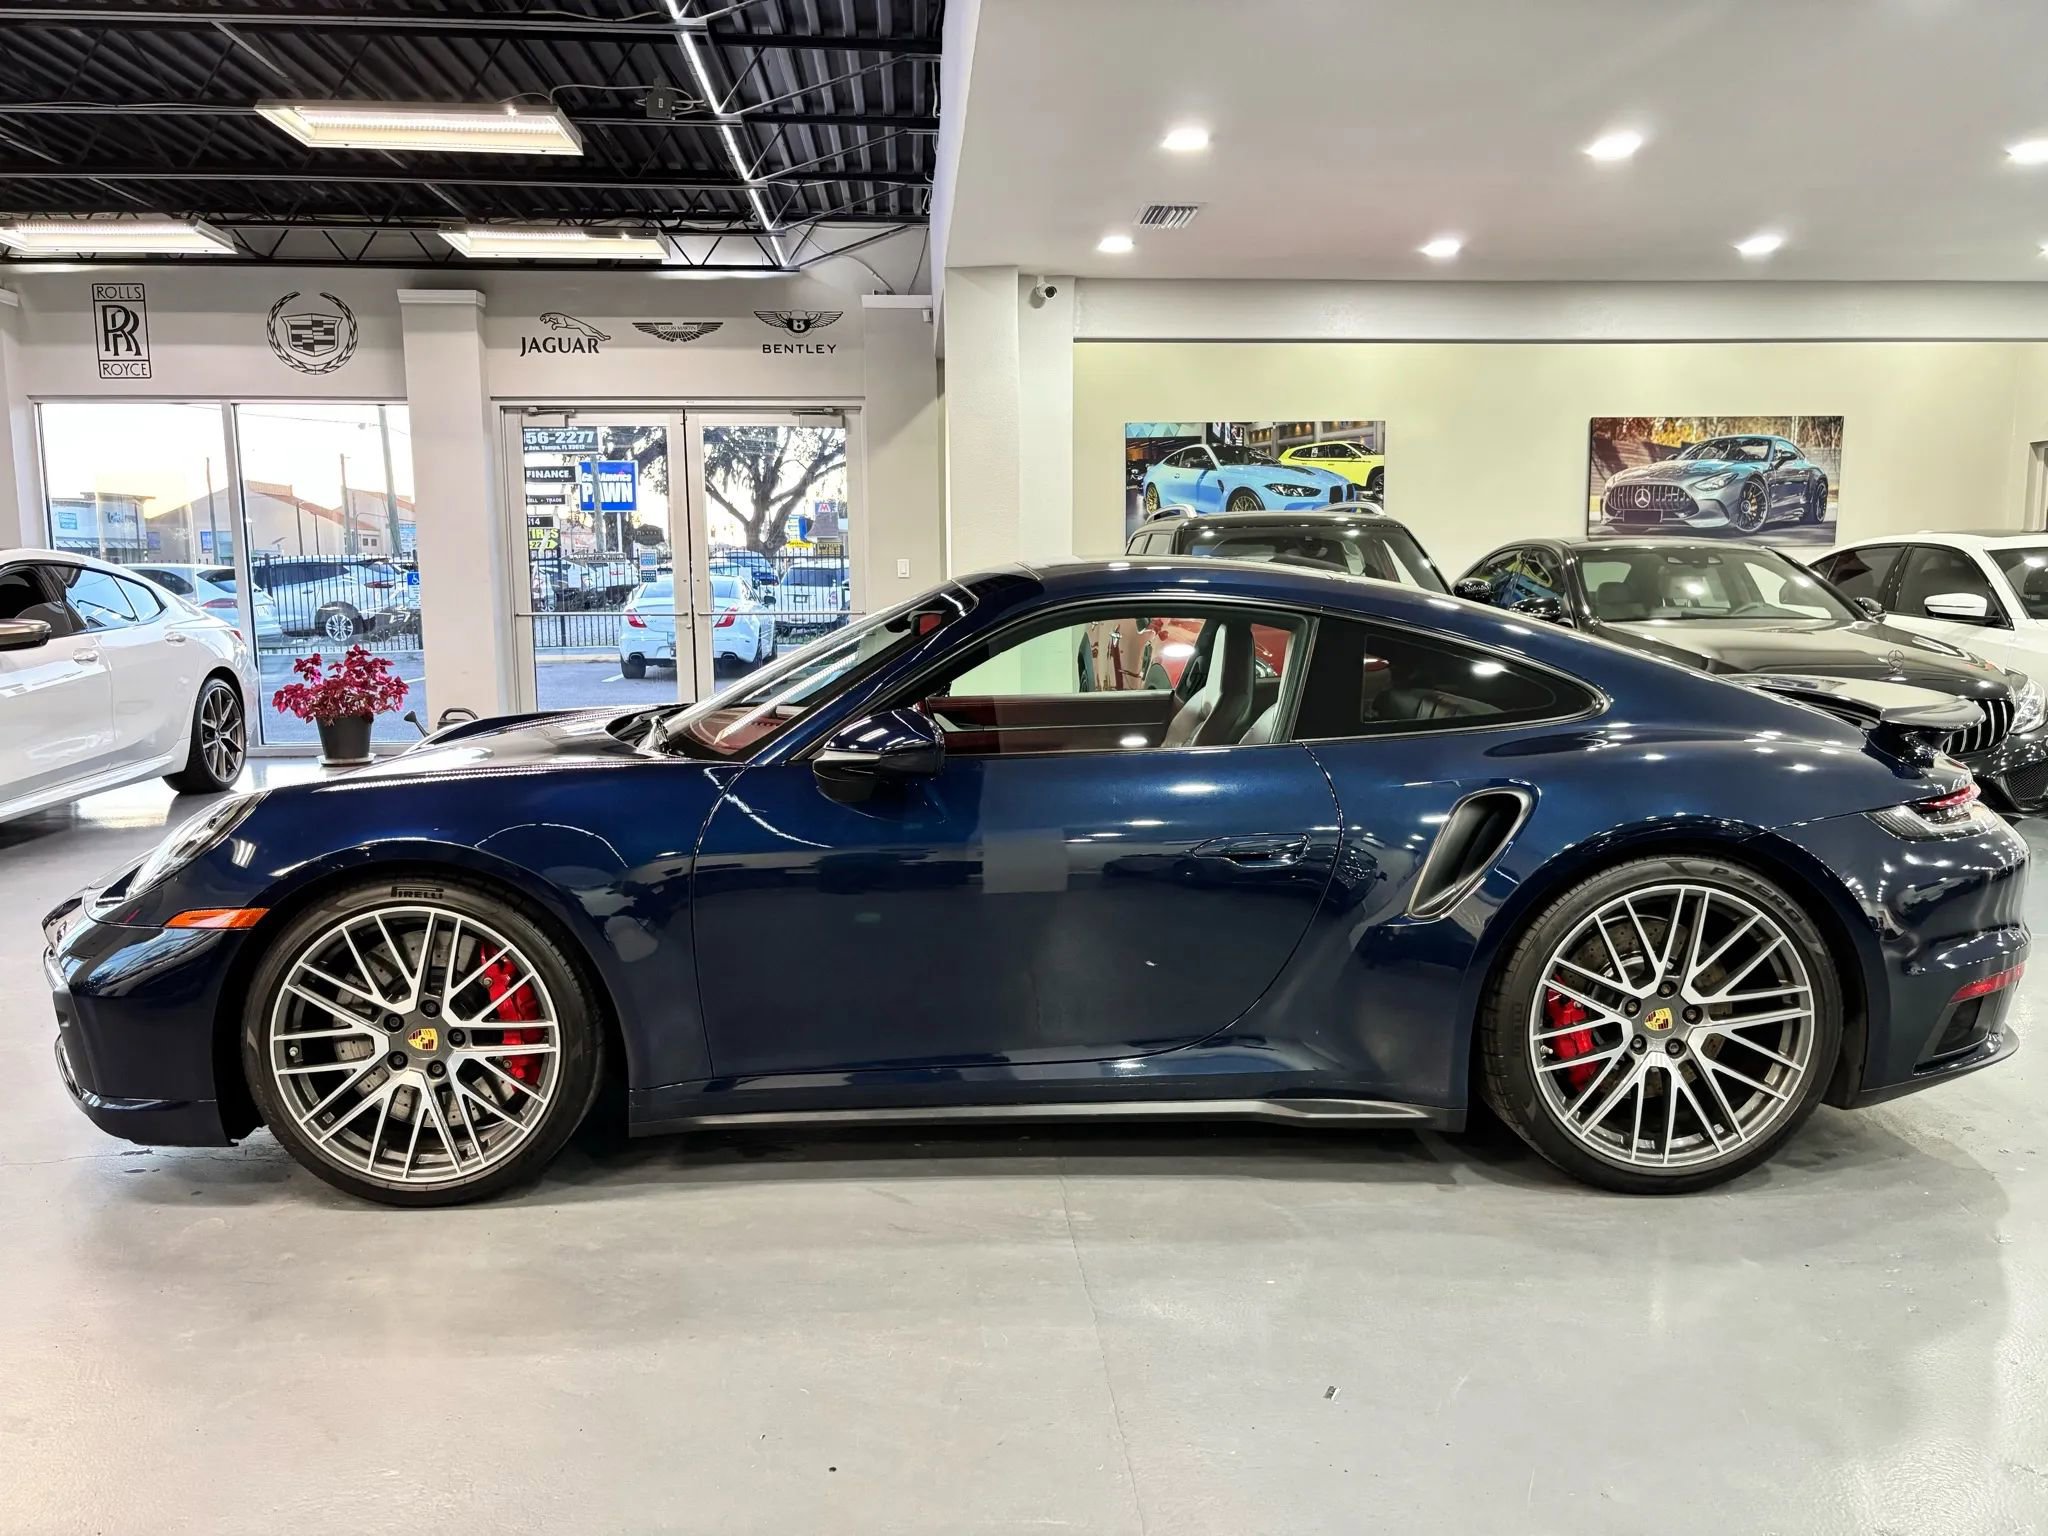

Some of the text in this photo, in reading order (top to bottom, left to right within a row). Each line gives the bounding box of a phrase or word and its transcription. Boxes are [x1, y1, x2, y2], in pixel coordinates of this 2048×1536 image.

[96, 286, 142, 299] ROLLS
[520, 336, 600, 357] JAGUAR
[762, 343, 837, 354] BENTLEY
[102, 363, 148, 376] ROYCE
[524, 430, 595, 445] 56-2277
[526, 470, 569, 479] FINANCE
[582, 471, 632, 482] Ca America
[391, 886, 444, 899] PIRELLI
[1733, 873, 1804, 923] ZERO
